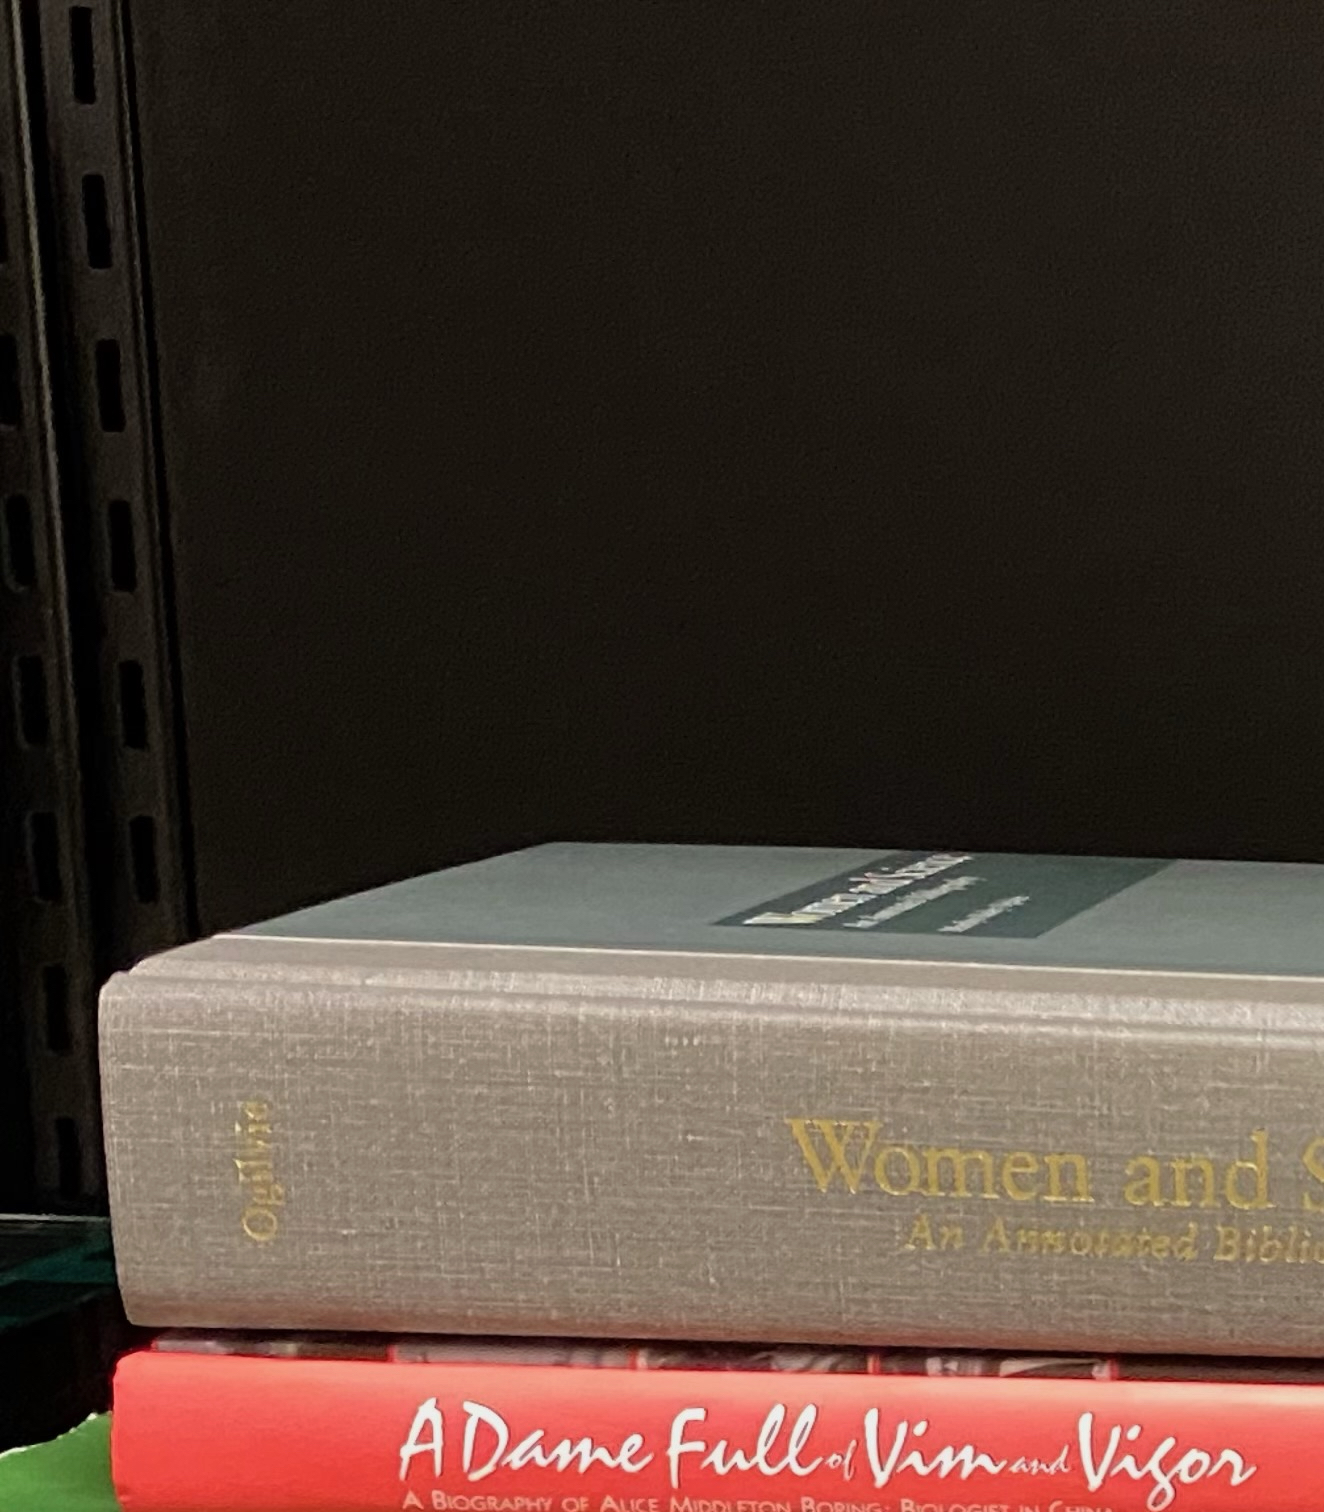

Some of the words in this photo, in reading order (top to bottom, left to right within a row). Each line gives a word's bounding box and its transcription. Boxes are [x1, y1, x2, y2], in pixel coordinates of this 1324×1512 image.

[232, 1101, 286, 1241] Ogilvie
[787, 1117, 1095, 1202] Women
[1124, 1128, 1274, 1210] and
[905, 1212, 964, 1252] An
[983, 1216, 1198, 1262] Annotated
[399, 1399, 445, 1482] A
[462, 1402, 654, 1479] Dame
[667, 1402, 827, 1486] Full
[826, 1439, 858, 1482] of
[864, 1406, 1006, 1489] Vim
[1009, 1445, 1069, 1479] and
[403, 1492, 425, 1511] A
[561, 1494, 591, 1512] OF
